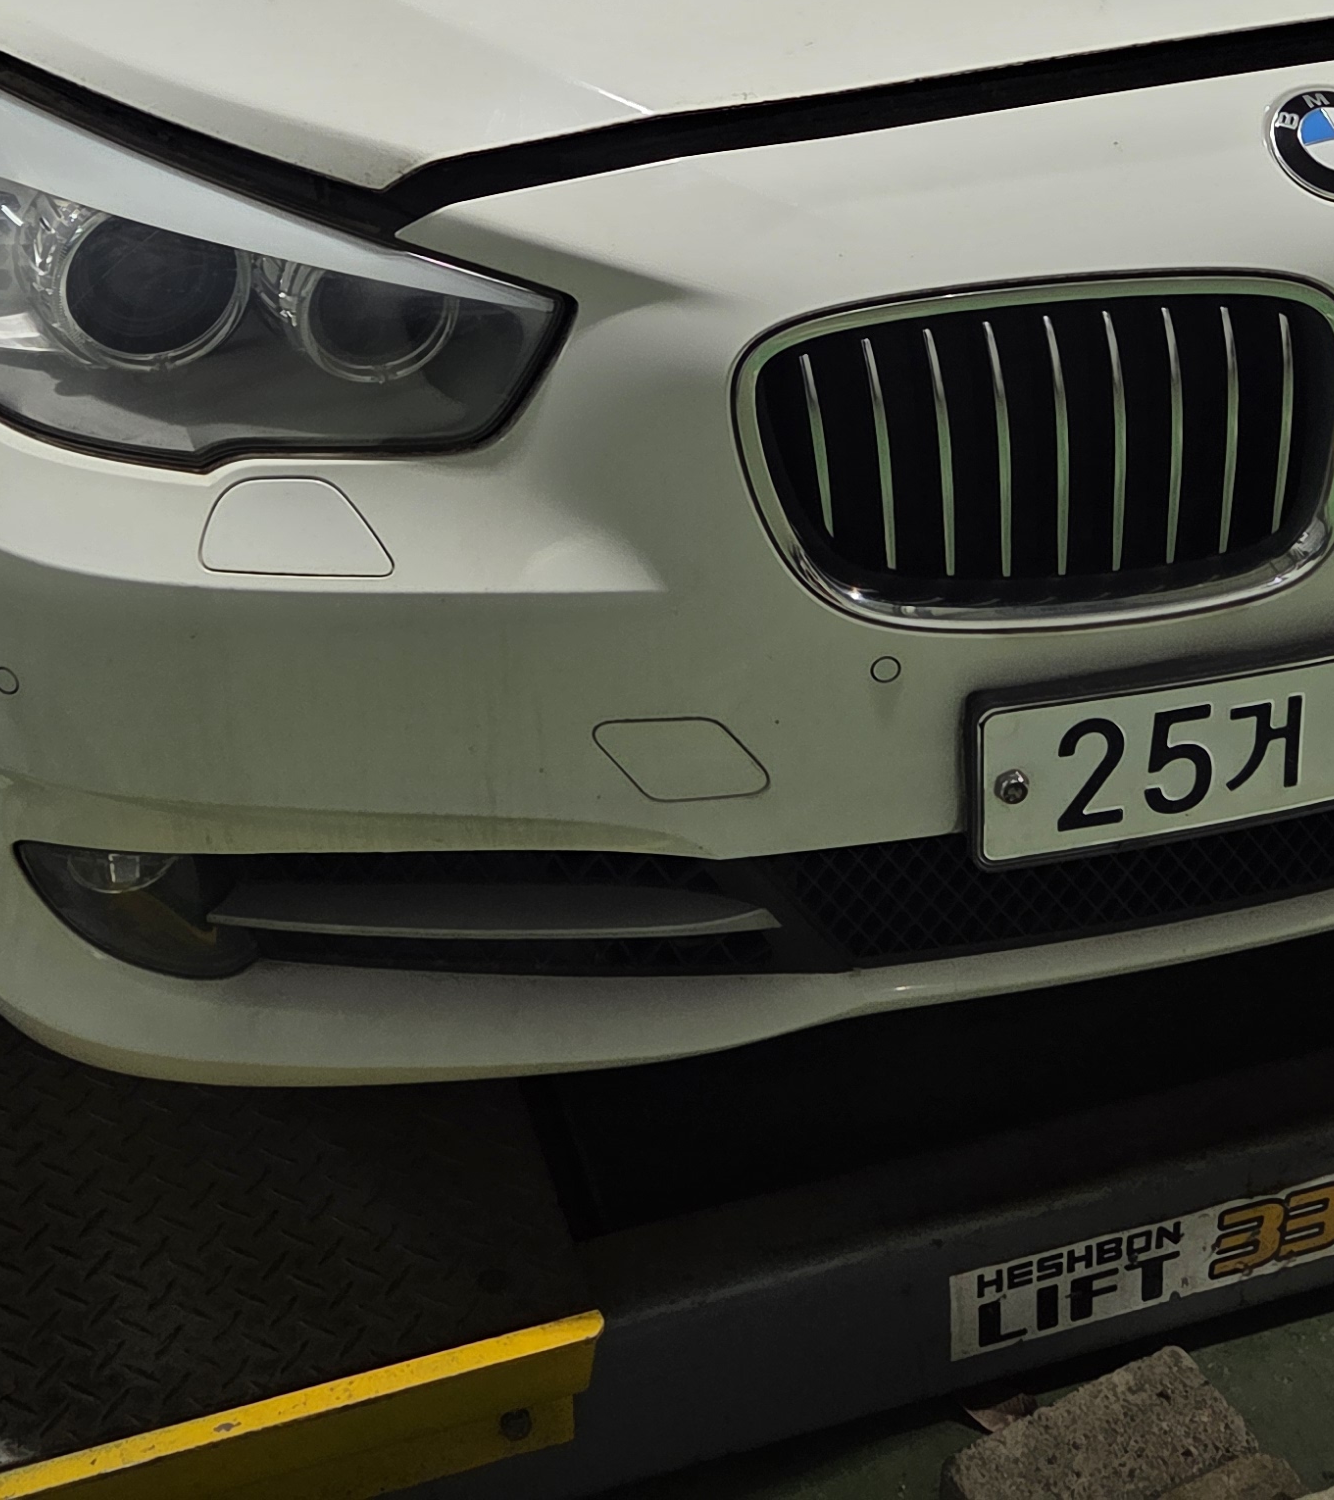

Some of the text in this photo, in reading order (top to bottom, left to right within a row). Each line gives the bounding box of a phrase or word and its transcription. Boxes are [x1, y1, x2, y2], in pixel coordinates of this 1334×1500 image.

[1055, 694, 1304, 832] 25거
[976, 1220, 1184, 1299] HESHBON
[977, 1250, 1181, 1348] LIFT
